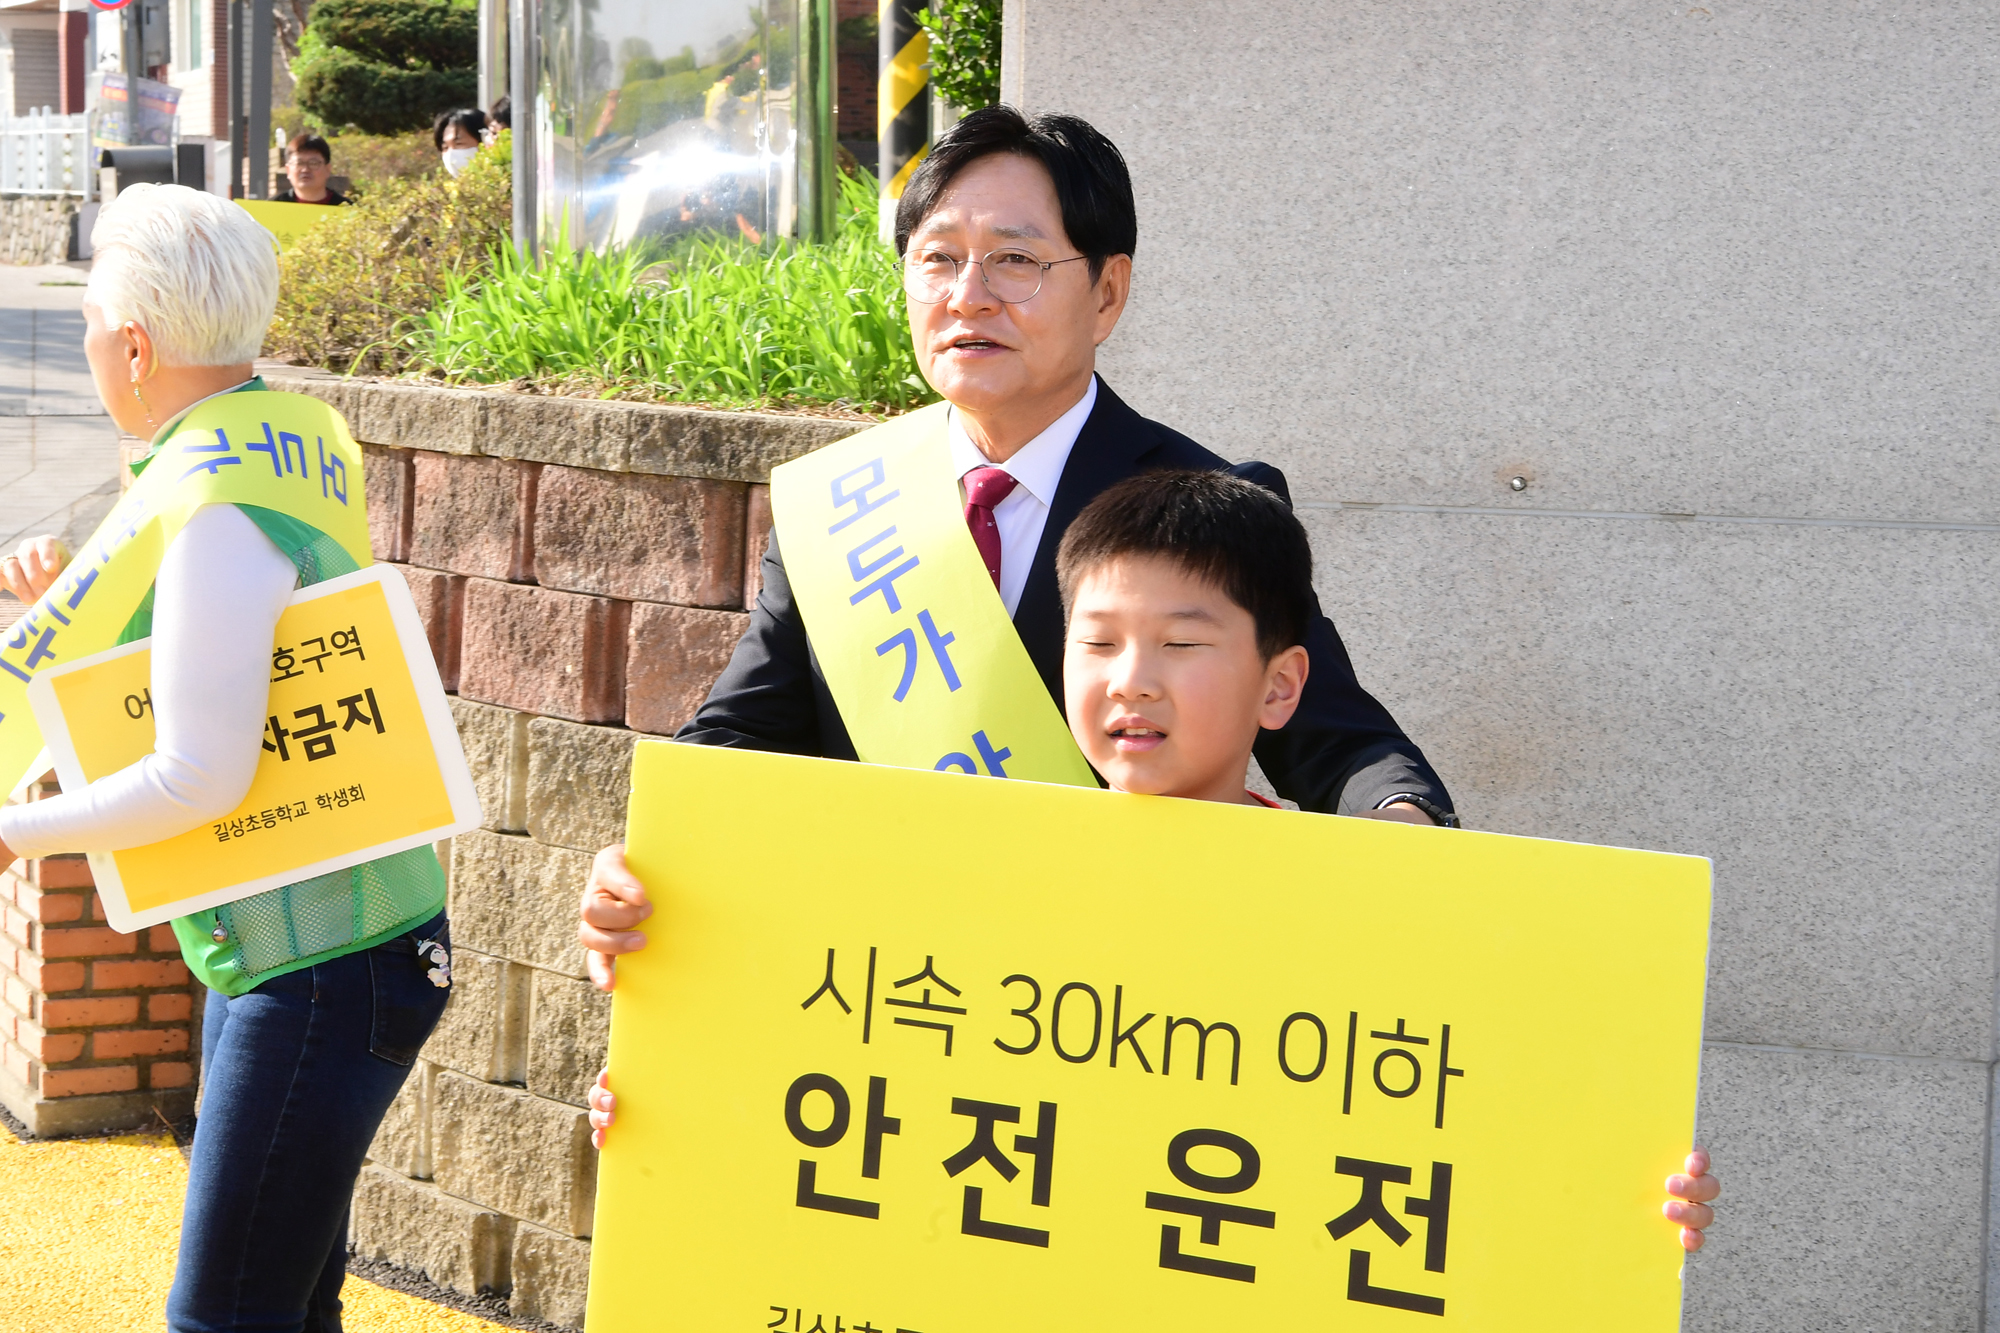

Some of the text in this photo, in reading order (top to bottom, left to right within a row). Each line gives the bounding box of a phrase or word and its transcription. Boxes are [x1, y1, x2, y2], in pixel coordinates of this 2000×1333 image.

[177, 422, 348, 506] 모두가
[828, 457, 962, 703] 모두가
[269, 625, 366, 683] 호구역
[262, 687, 386, 762] 차금지
[213, 783, 366, 843] 길상초등학교 학생회
[801, 946, 1465, 1130] 시속 30km 이하
[784, 1072, 1453, 1317] 안전 운전
